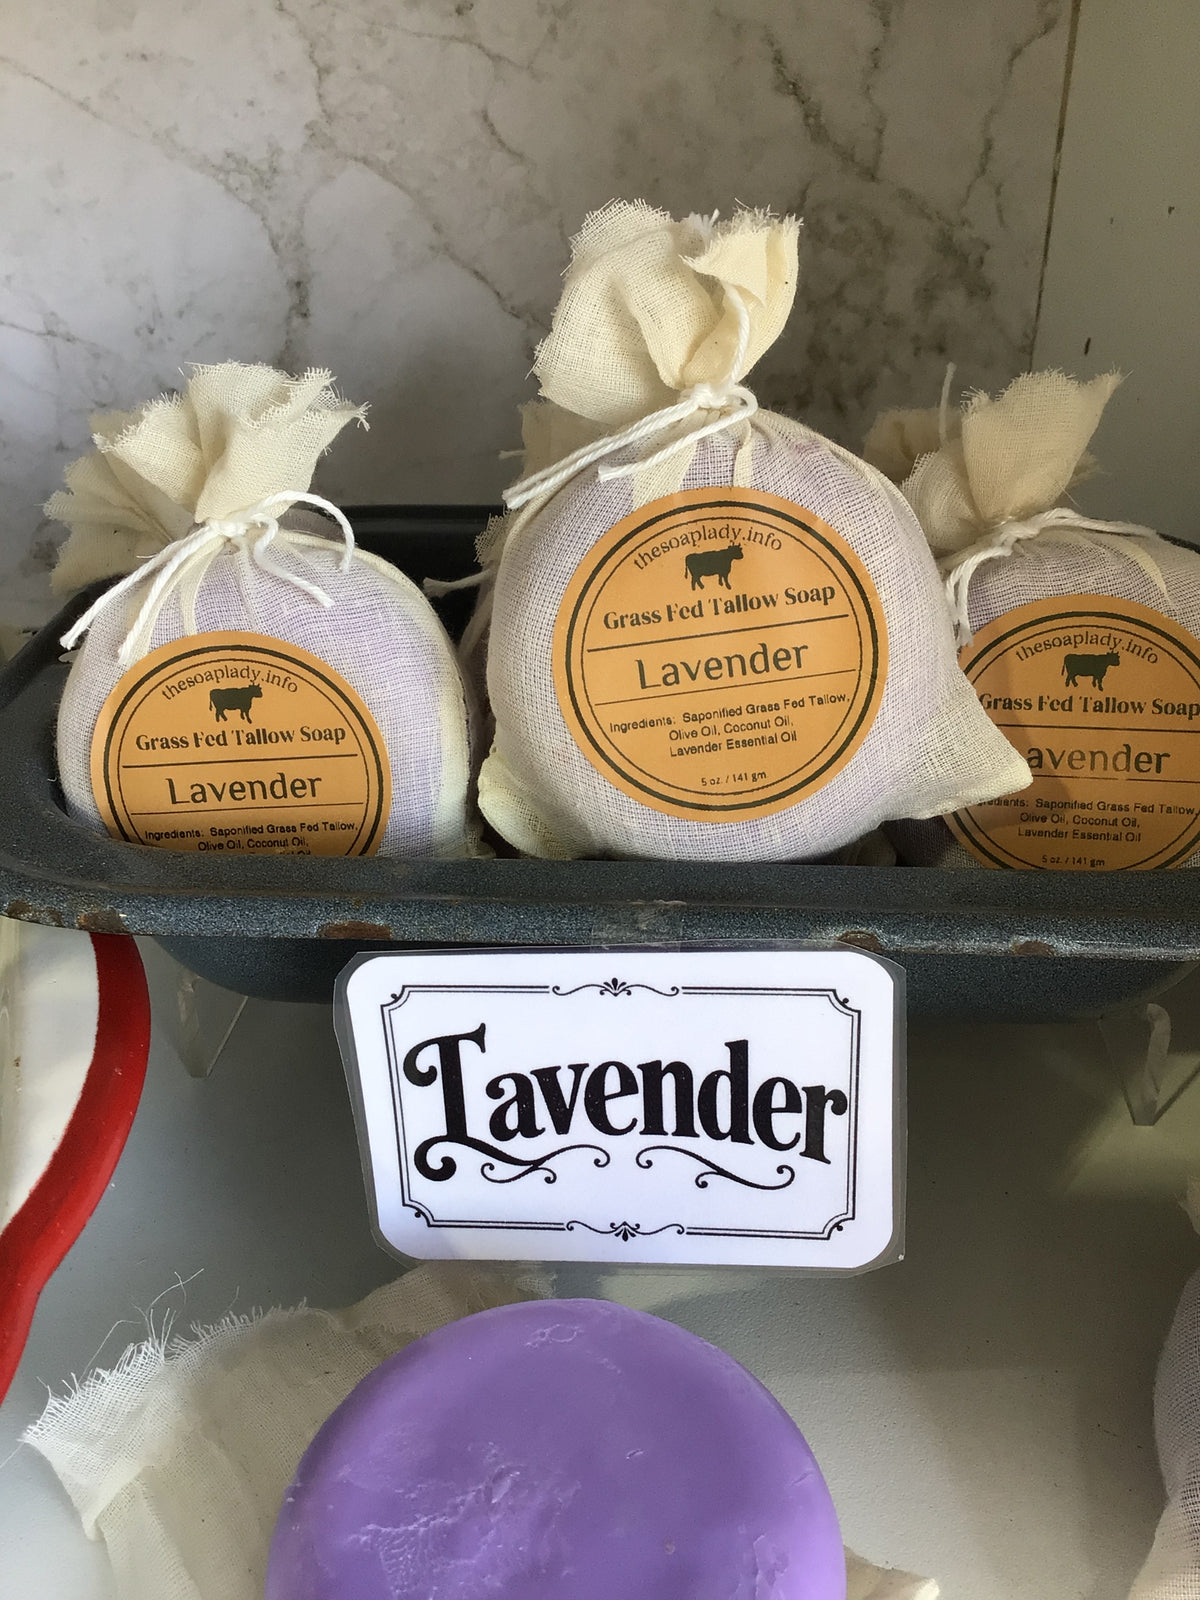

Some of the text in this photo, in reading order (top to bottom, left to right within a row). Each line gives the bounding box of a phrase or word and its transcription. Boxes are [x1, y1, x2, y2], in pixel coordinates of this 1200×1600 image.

[633, 524, 782, 571] thesoaplady.info
[603, 585, 836, 630] Grass Fed Tallow Soap
[1015, 631, 1159, 664] thesoaplady.info
[635, 642, 808, 690] Lavender
[161, 665, 298, 700] thesoaplady.info
[610, 716, 677, 733] Ingredients:
[682, 705, 742, 724] Saponified
[746, 703, 781, 715] Grass
[783, 697, 805, 709] Fed
[979, 693, 1200, 720] Grass Fed Tallow Soap
[135, 726, 346, 751] Grass Fed Tallow Soap
[669, 729, 698, 741] Olive
[723, 719, 771, 734] Coconut
[670, 730, 798, 757] Lavender Essential Oil
[1026, 743, 1170, 774] avender
[165, 772, 322, 805] Lavender
[701, 777, 708, 786] 5
[732, 772, 748, 783] 141
[751, 771, 767, 782] gm
[1035, 798, 1093, 810] Saponified
[1097, 800, 1130, 812] Grass
[1134, 802, 1155, 813] Fed
[145, 829, 205, 841] Ingredients:
[209, 824, 264, 838] Saponified
[266, 823, 297, 834] Grass
[300, 822, 319, 832] Fed
[1020, 812, 1048, 824] Olive
[1072, 815, 1118, 827] Coconut
[198, 840, 224, 851] Olive
[247, 838, 289, 849] Coconut
[1018, 827, 1141, 842] Lavender Essential Oil
[1072, 856, 1087, 865] 141
[1090, 858, 1105, 868] gm
[403, 1023, 848, 1182] Lavender
